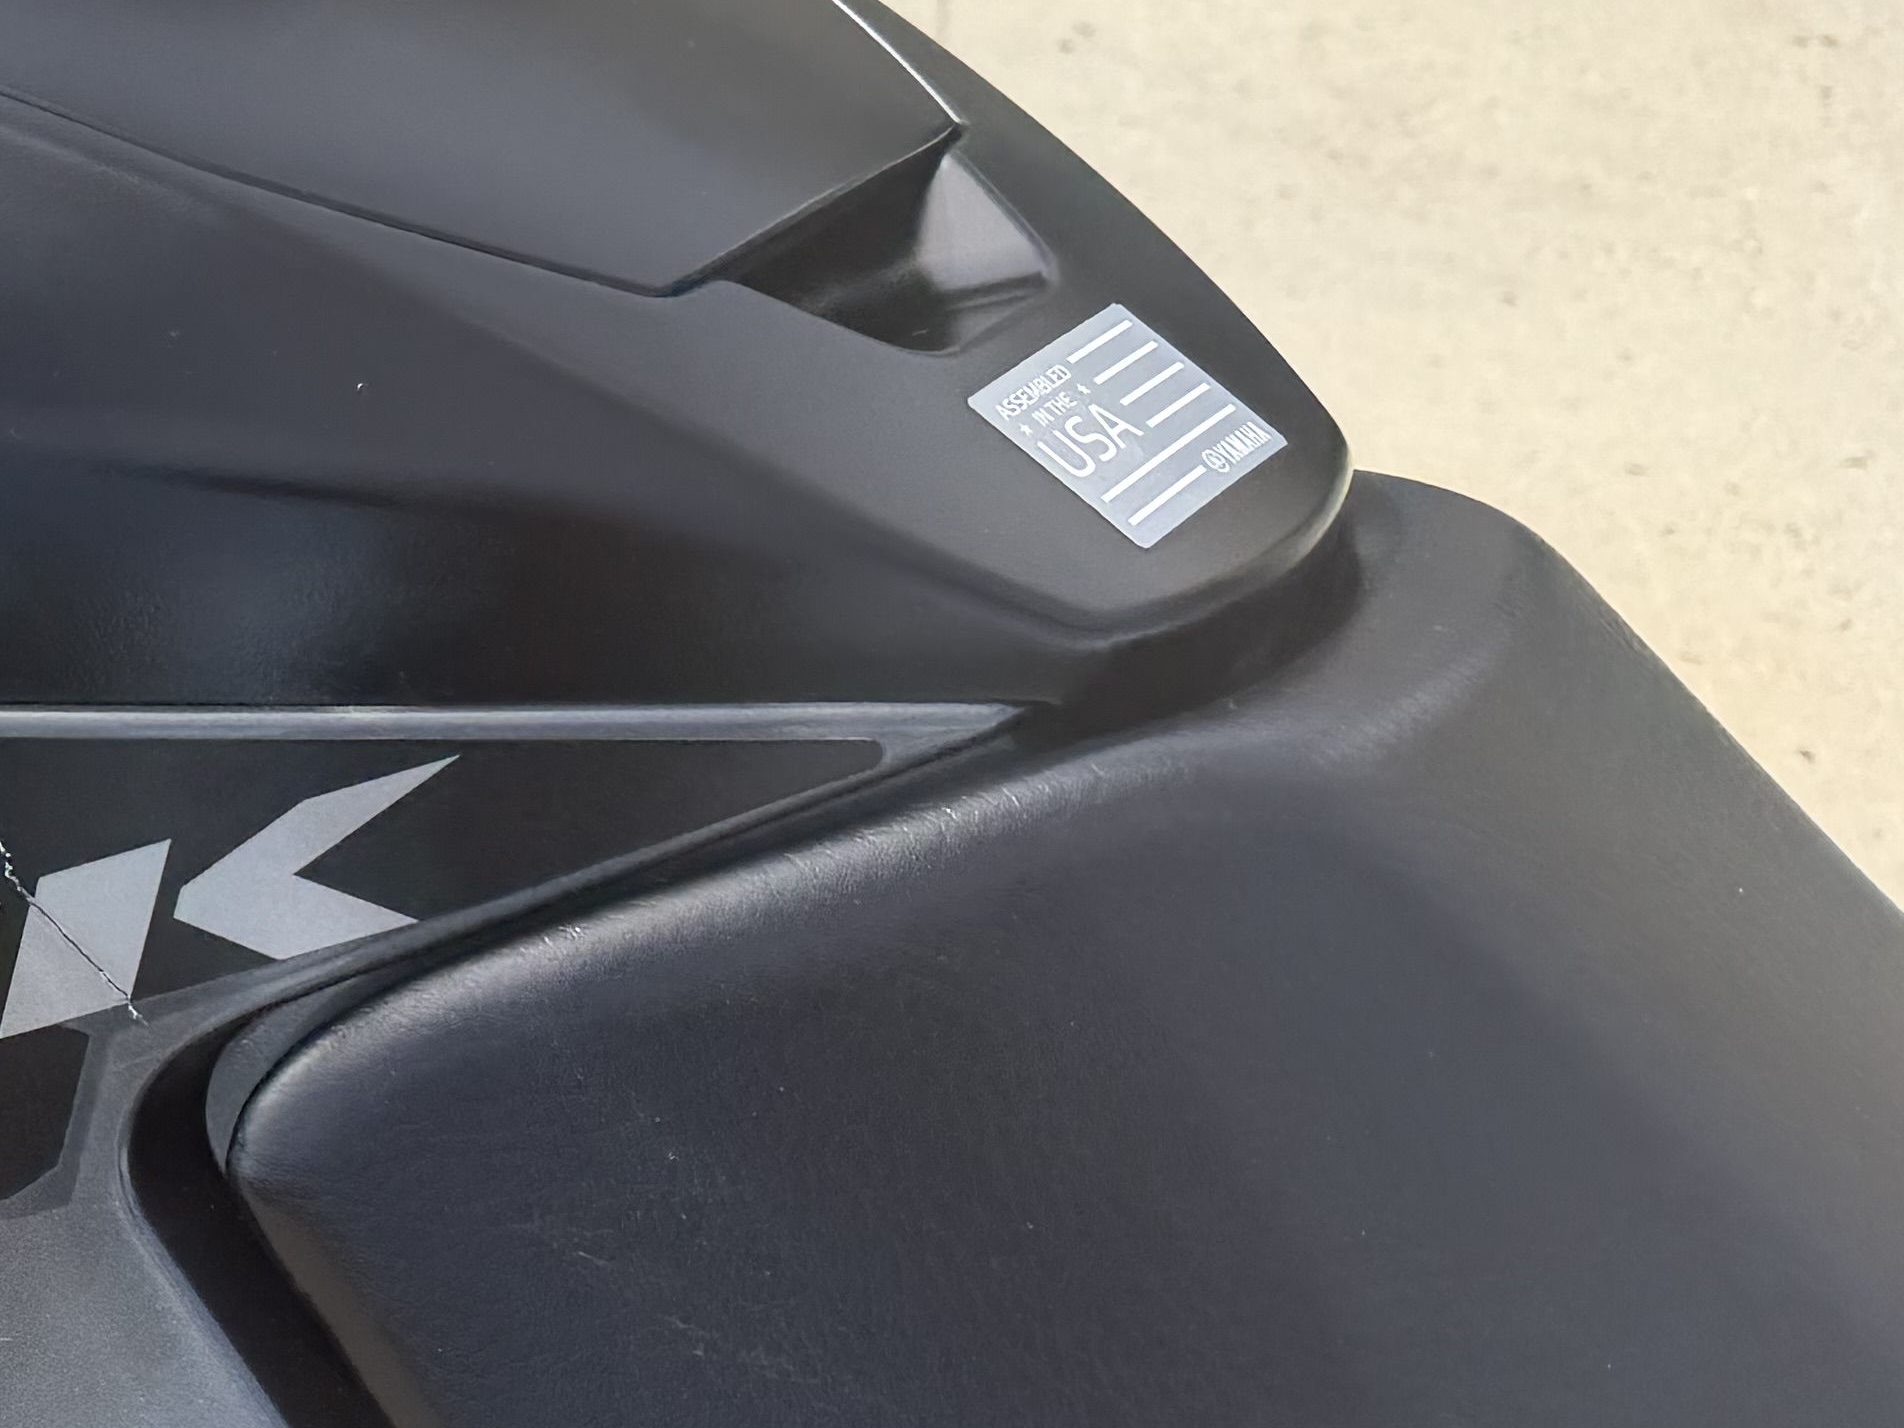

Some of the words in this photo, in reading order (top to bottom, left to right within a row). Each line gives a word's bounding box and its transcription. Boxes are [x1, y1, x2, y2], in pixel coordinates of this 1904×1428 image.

[995, 364, 1072, 422] ASSEMBLED
[1031, 408, 1055, 427] IN
[1043, 391, 1078, 416] THE
[1037, 404, 1144, 478] USA
[1212, 421, 1272, 464] YAMAHA
